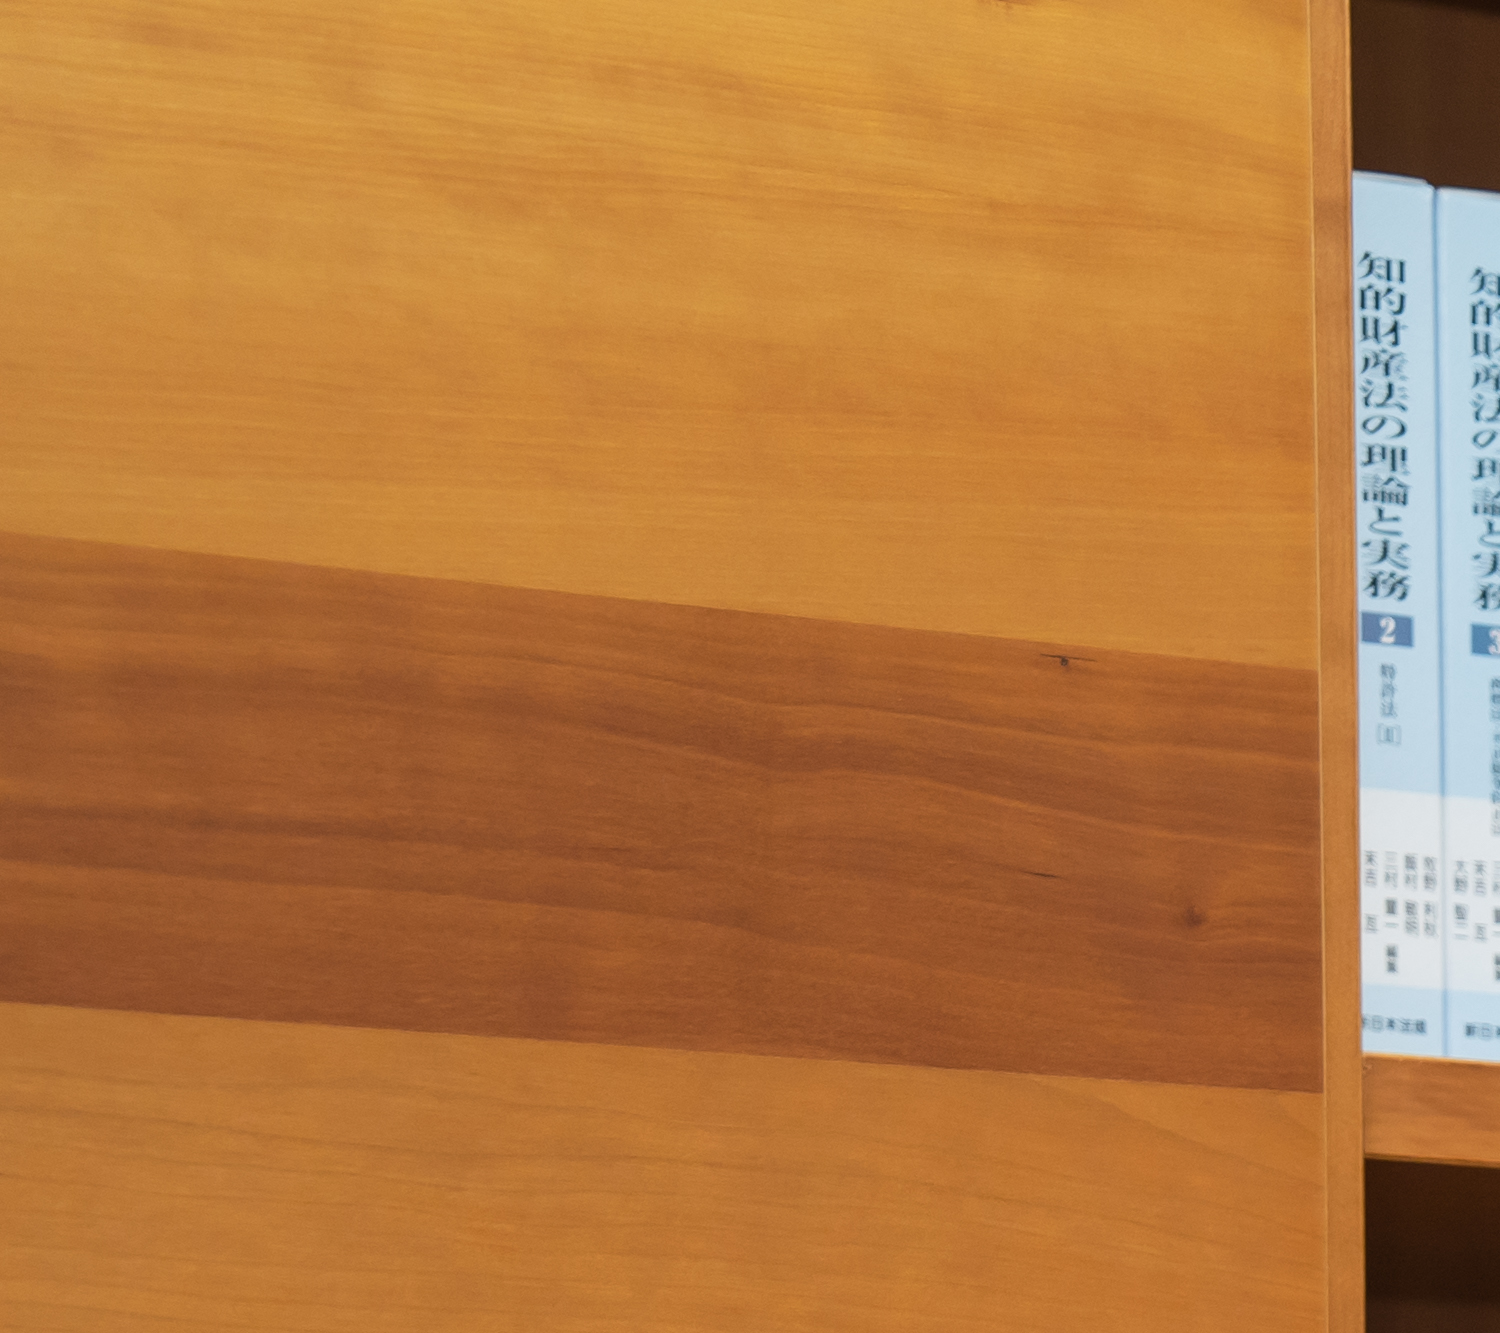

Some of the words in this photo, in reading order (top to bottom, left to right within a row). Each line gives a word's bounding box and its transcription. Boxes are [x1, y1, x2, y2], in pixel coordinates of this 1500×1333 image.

[1358, 251, 1411, 602] 知的財産法の理論と実務
[1379, 616, 1397, 644] 2
